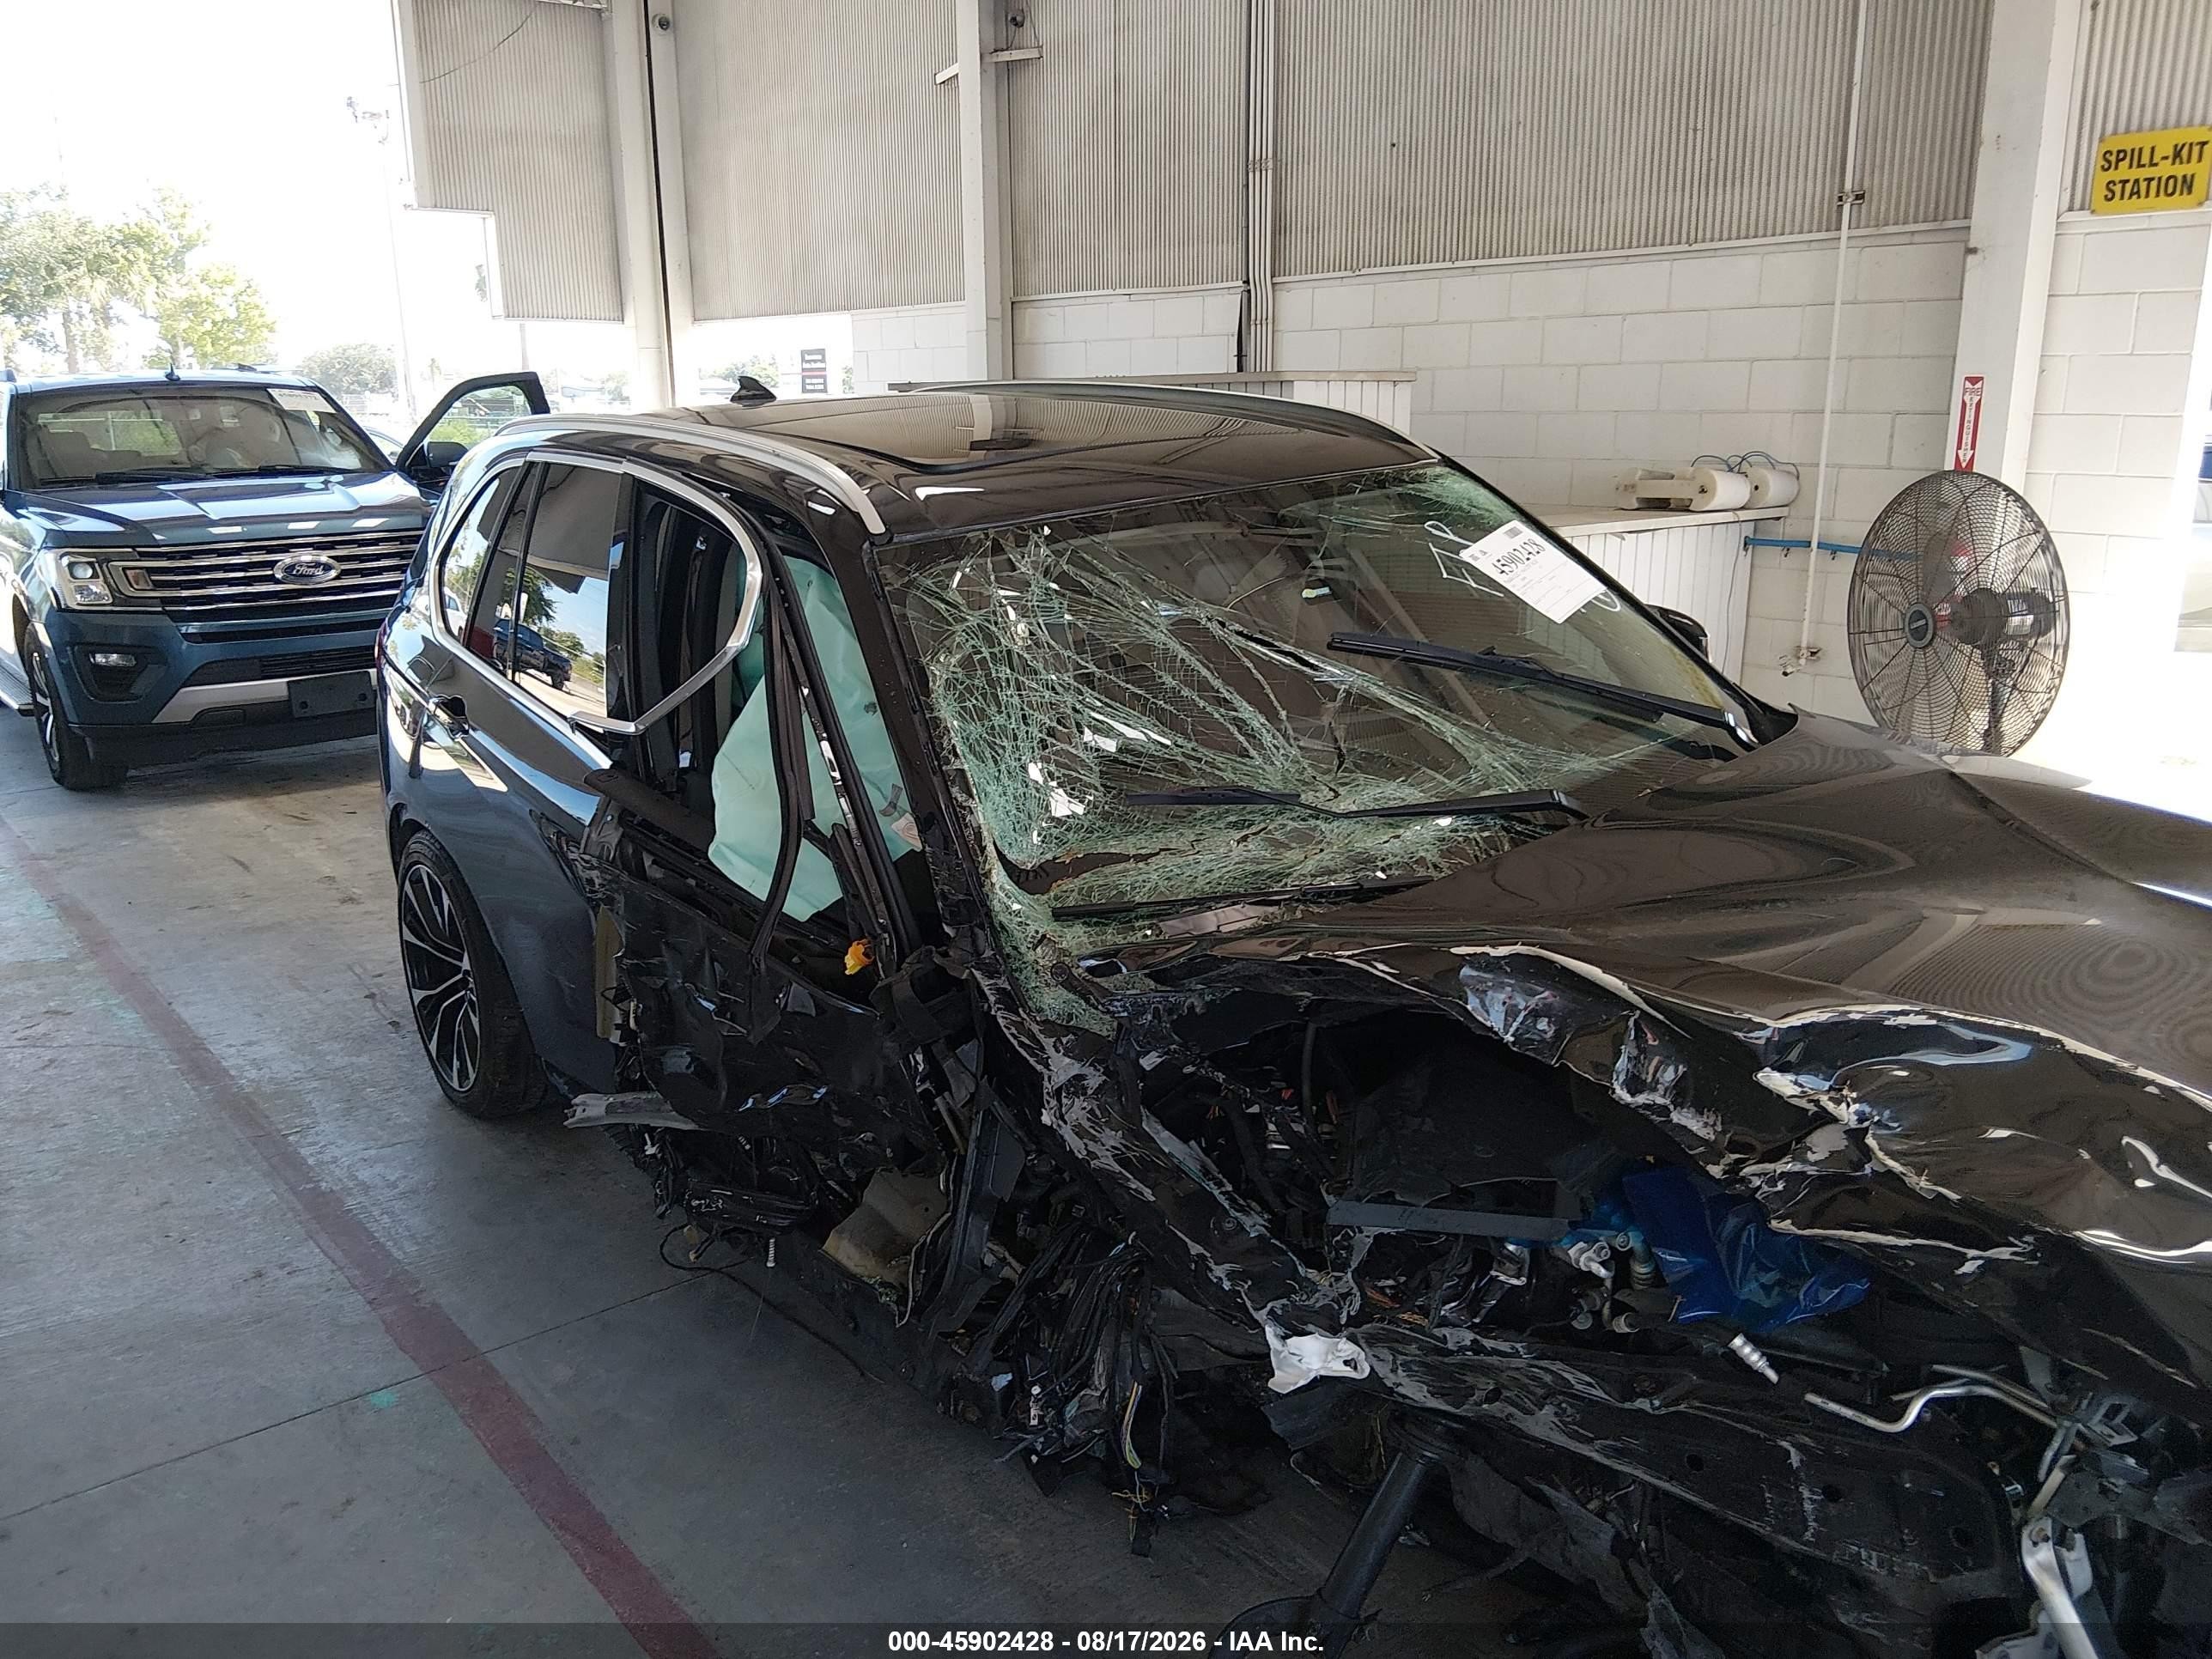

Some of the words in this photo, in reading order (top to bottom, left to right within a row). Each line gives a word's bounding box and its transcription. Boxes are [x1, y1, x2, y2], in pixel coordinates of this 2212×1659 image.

[2100, 140, 2209, 172] SPILL-KIT
[2104, 173, 2197, 203] STATION
[1964, 386, 1981, 398] FIRE
[1492, 538, 1547, 576] 45902428
